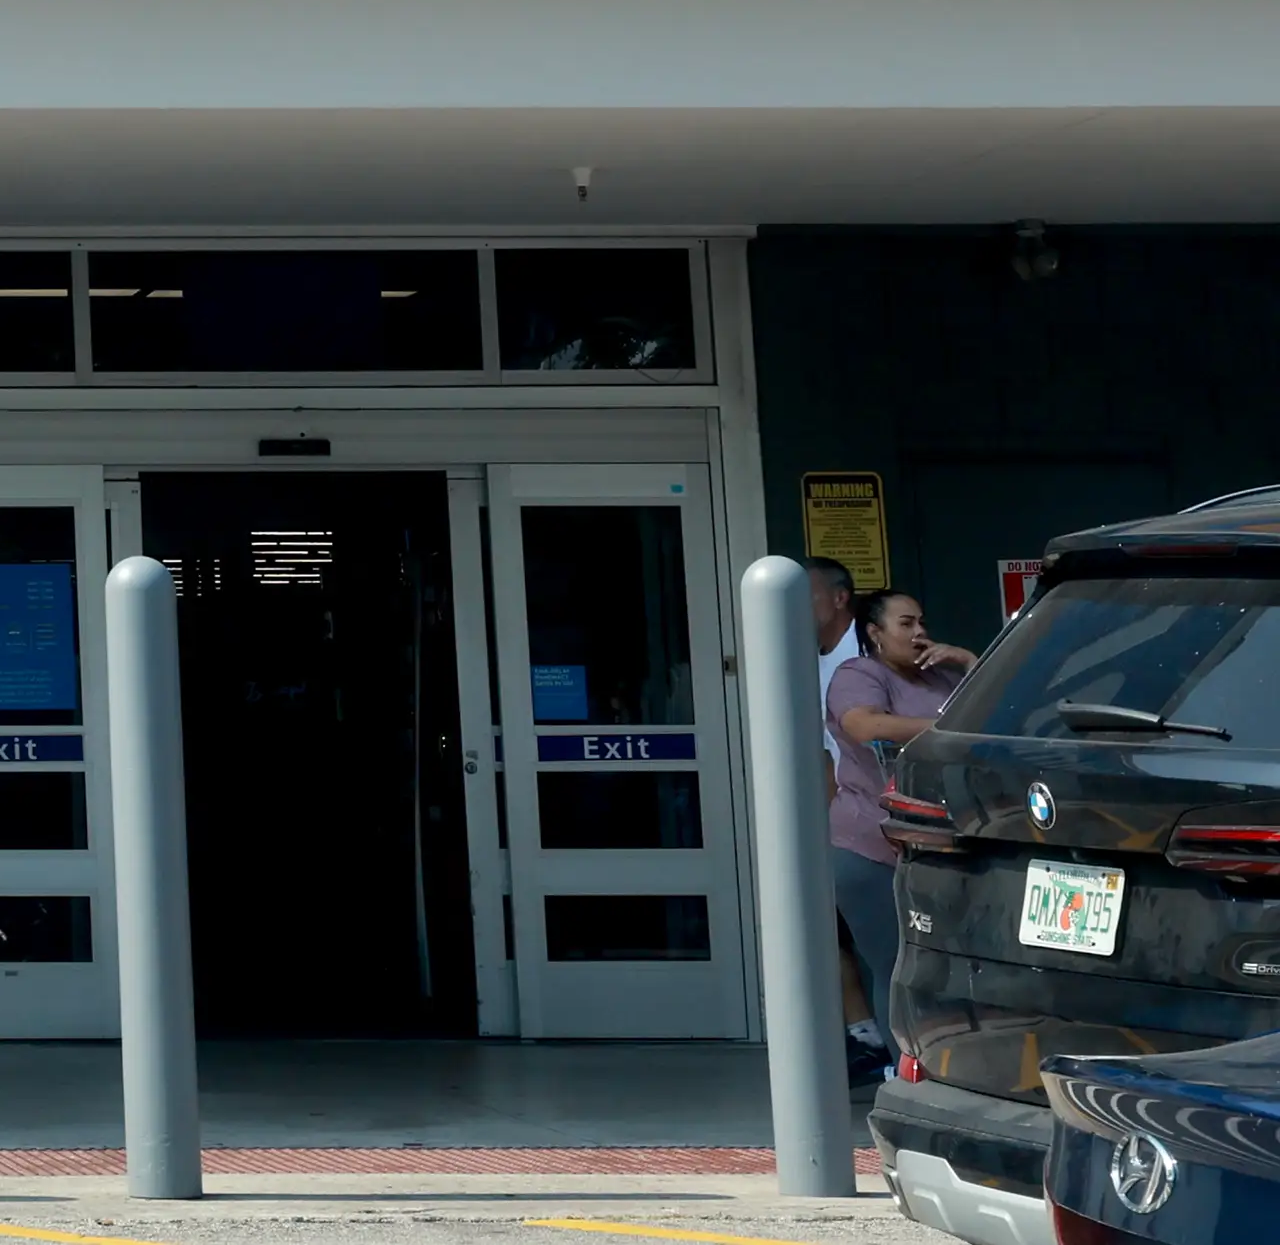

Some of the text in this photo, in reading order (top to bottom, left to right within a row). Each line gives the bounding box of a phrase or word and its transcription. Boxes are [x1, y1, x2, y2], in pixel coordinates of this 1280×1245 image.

[809, 482, 874, 498] WARNING
[1007, 562, 1021, 572] DO
[583, 736, 650, 760] Exit
[908, 909, 932, 934] X5
